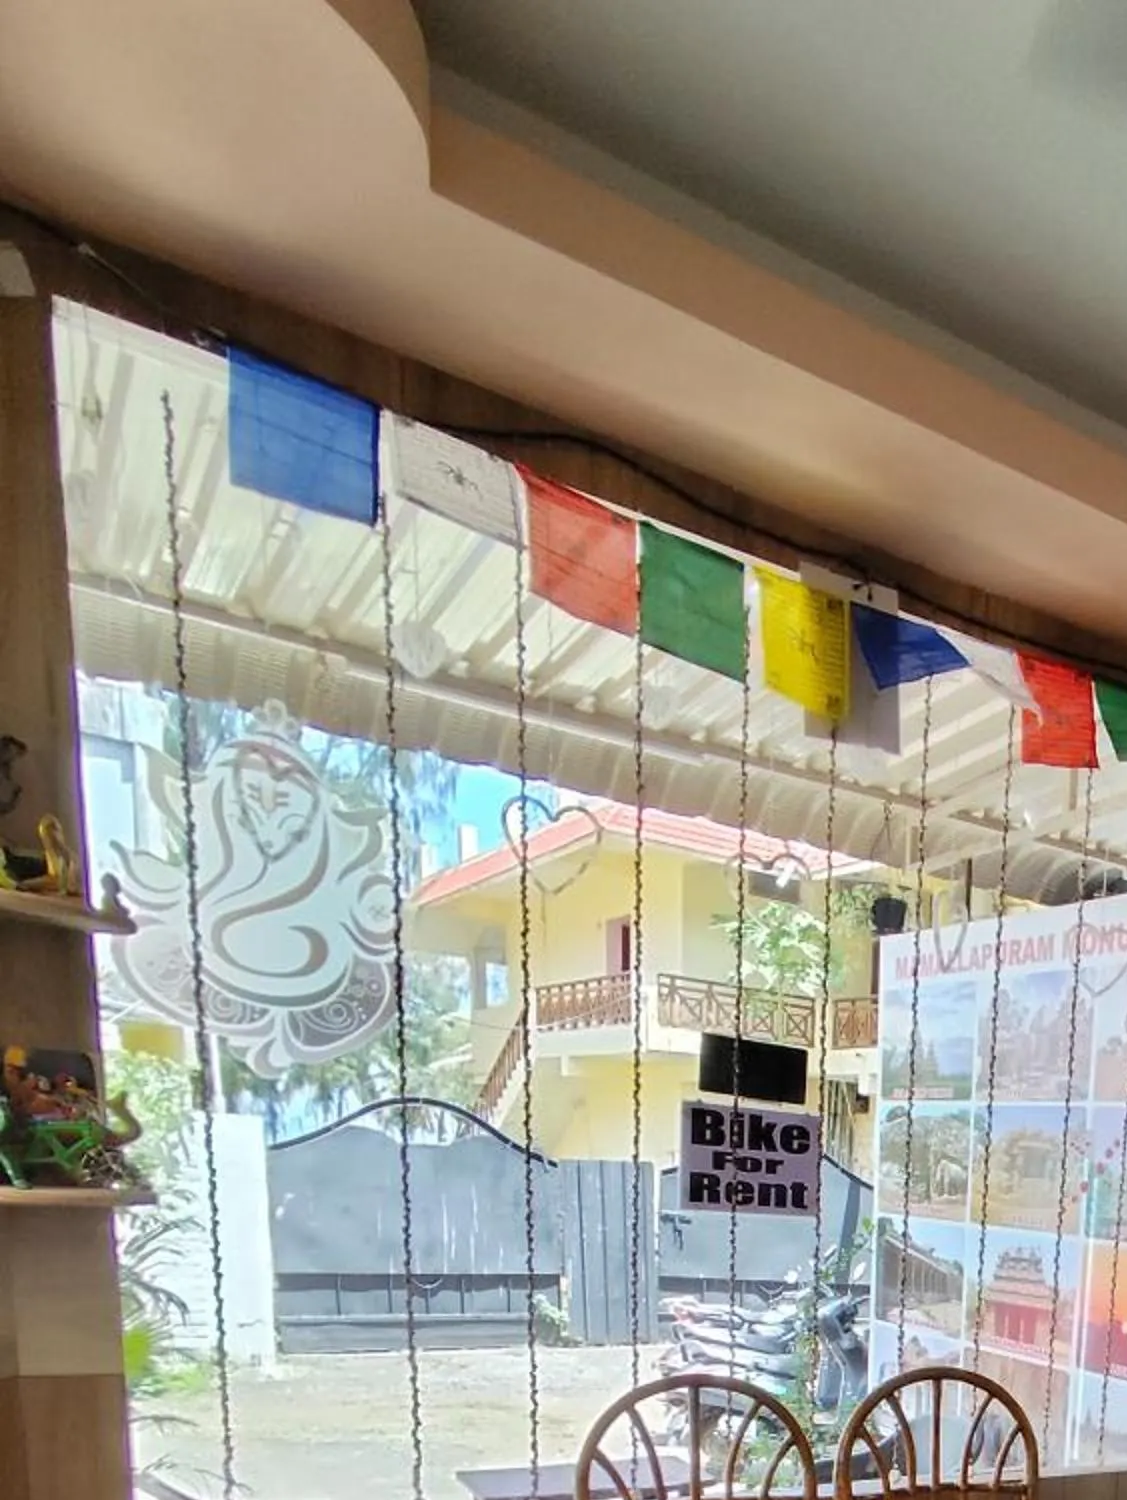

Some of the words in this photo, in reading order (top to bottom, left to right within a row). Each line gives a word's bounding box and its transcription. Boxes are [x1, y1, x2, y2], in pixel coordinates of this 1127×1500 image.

[692, 1108, 811, 1154] Bike
[713, 1152, 785, 1174] For
[690, 1172, 809, 1209] Rent
